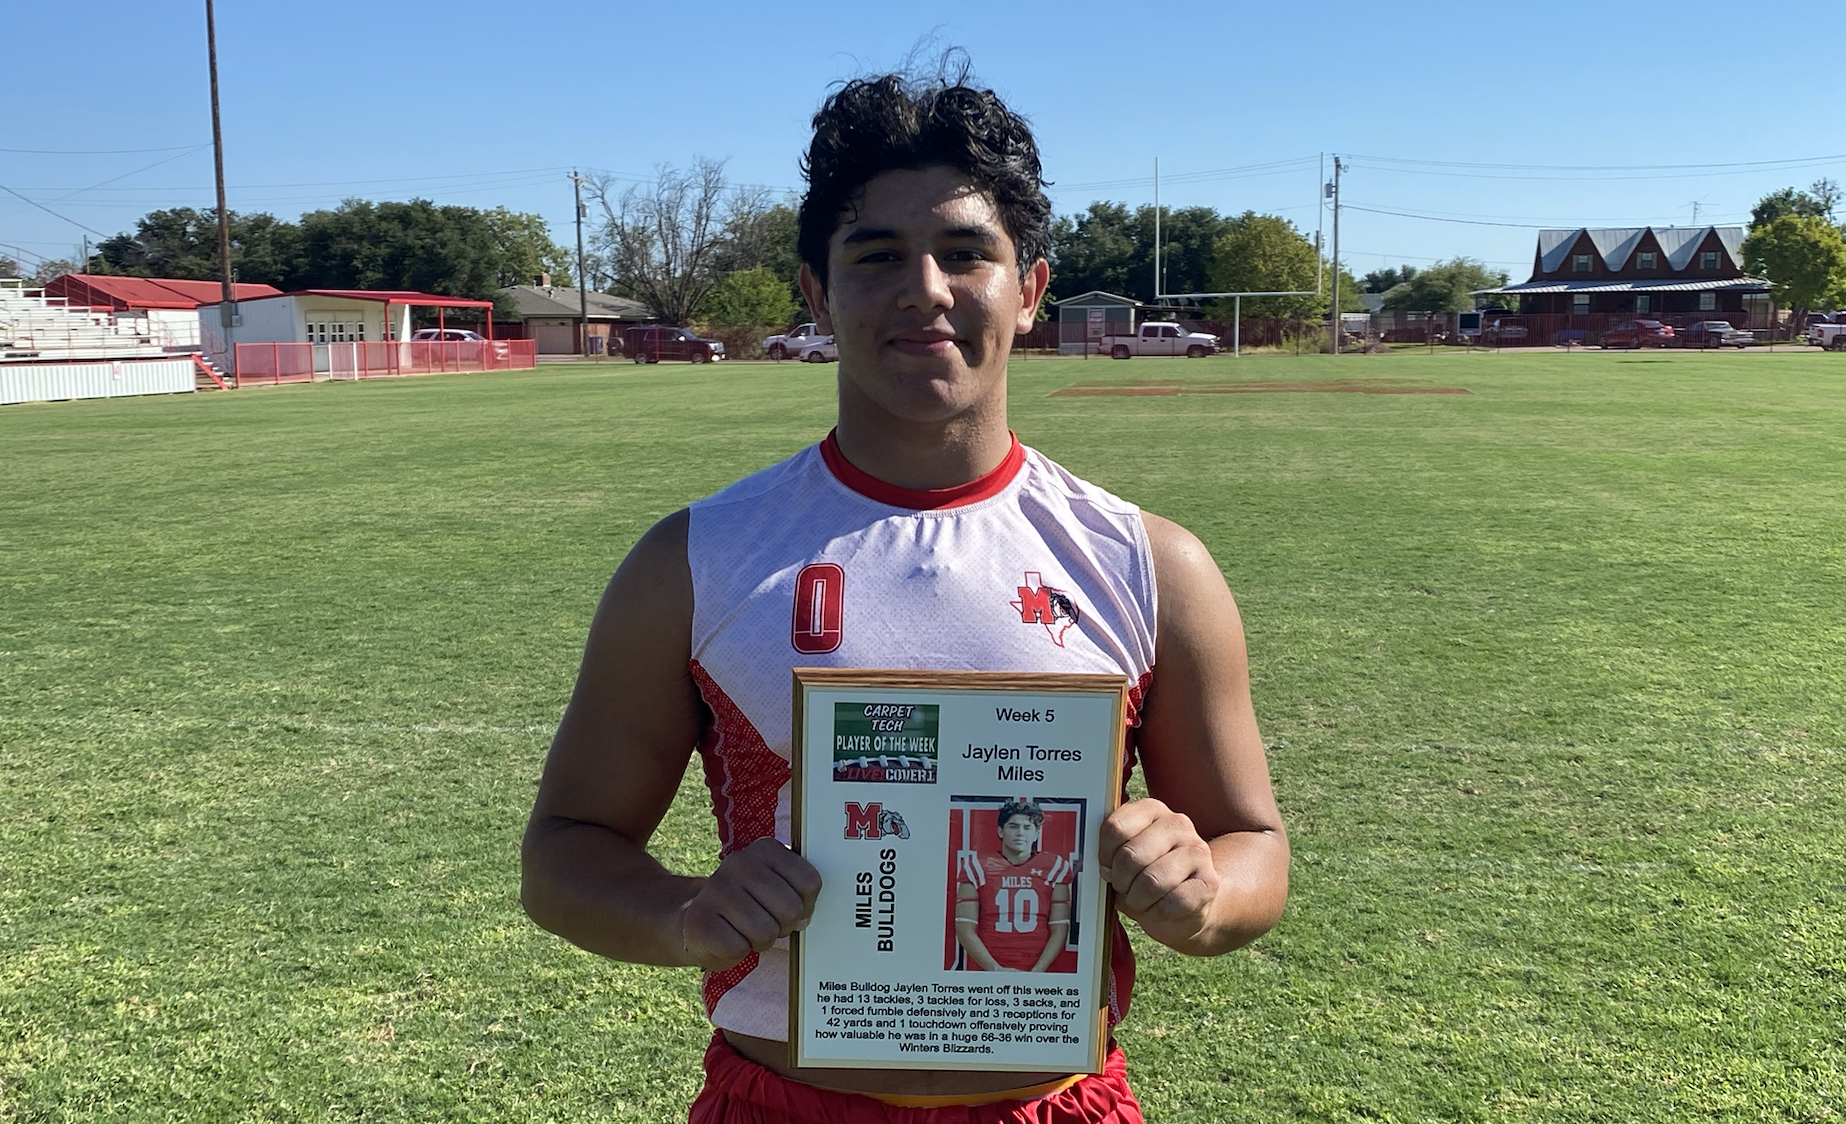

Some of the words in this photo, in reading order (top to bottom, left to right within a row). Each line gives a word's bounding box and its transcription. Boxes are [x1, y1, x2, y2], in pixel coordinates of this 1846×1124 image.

[1017, 586, 1056, 625] M
[863, 705, 915, 718] CARPET
[996, 707, 1040, 722] Week
[1045, 709, 1055, 722] 5
[872, 719, 904, 732] TECH
[836, 735, 871, 751] PLAYER
[873, 735, 887, 751] OF
[889, 736, 906, 752] THE
[909, 736, 936, 753] WEEK
[962, 744, 1020, 763] Jaylen
[1026, 745, 1082, 762] Torres
[997, 765, 1044, 781] Miles
[844, 802, 883, 840] M
[1001, 876, 1032, 888] MILES
[855, 872, 873, 928] MILES
[877, 849, 896, 952] BULLDOGS
[994, 888, 1039, 933] 10
[819, 981, 847, 991] Miles
[850, 982, 890, 993] Bulldog
[894, 983, 928, 994] Jaylen
[932, 984, 964, 994] Torres
[968, 985, 994, 994] went
[996, 985, 1011, 994] off
[1013, 986, 1032, 995] this
[1034, 986, 1063, 996] week
[816, 994, 830, 1003] he
[834, 994, 854, 1003] had
[858, 994, 870, 1003] 13
[873, 995, 914, 1005] tackles,
[917, 995, 924, 1004] 3
[927, 996, 964, 1005] tackles
[968, 996, 982, 1006] for
[985, 997, 1010, 1008] loss,
[1012, 997, 1020, 1007] 3
[1022, 998, 1057, 1009] sacks,
[1060, 999, 1080, 1008] and
[821, 1006, 827, 1014] 1
[830, 1006, 864, 1015] forced
[867, 1006, 904, 1016] fumble
[906, 1008, 966, 1020] defensively
[970, 1008, 990, 1018] and
[992, 1009, 1000, 1018] 3
[1002, 1010, 1058, 1020] receptions
[1060, 1010, 1076, 1020] for
[826, 1018, 840, 1027] 42
[843, 1018, 873, 1028] yards
[876, 1018, 896, 1028] and
[900, 1019, 905, 1028] 1
[909, 1020, 966, 1029] touchdown
[970, 1021, 1026, 1032] offensively
[1029, 1022, 1068, 1034] proving
[815, 1030, 838, 1039] how
[840, 1030, 885, 1040] valuable
[888, 1030, 902, 1040] he
[929, 1032, 938, 1040] in
[952, 1032, 978, 1043] huge
[981, 1032, 1012, 1042] 66-36
[1014, 1034, 1033, 1043] win
[1062, 1034, 1080, 1044] the
[899, 1042, 940, 1052] Winters
[943, 1044, 994, 1054] Blizzards.
